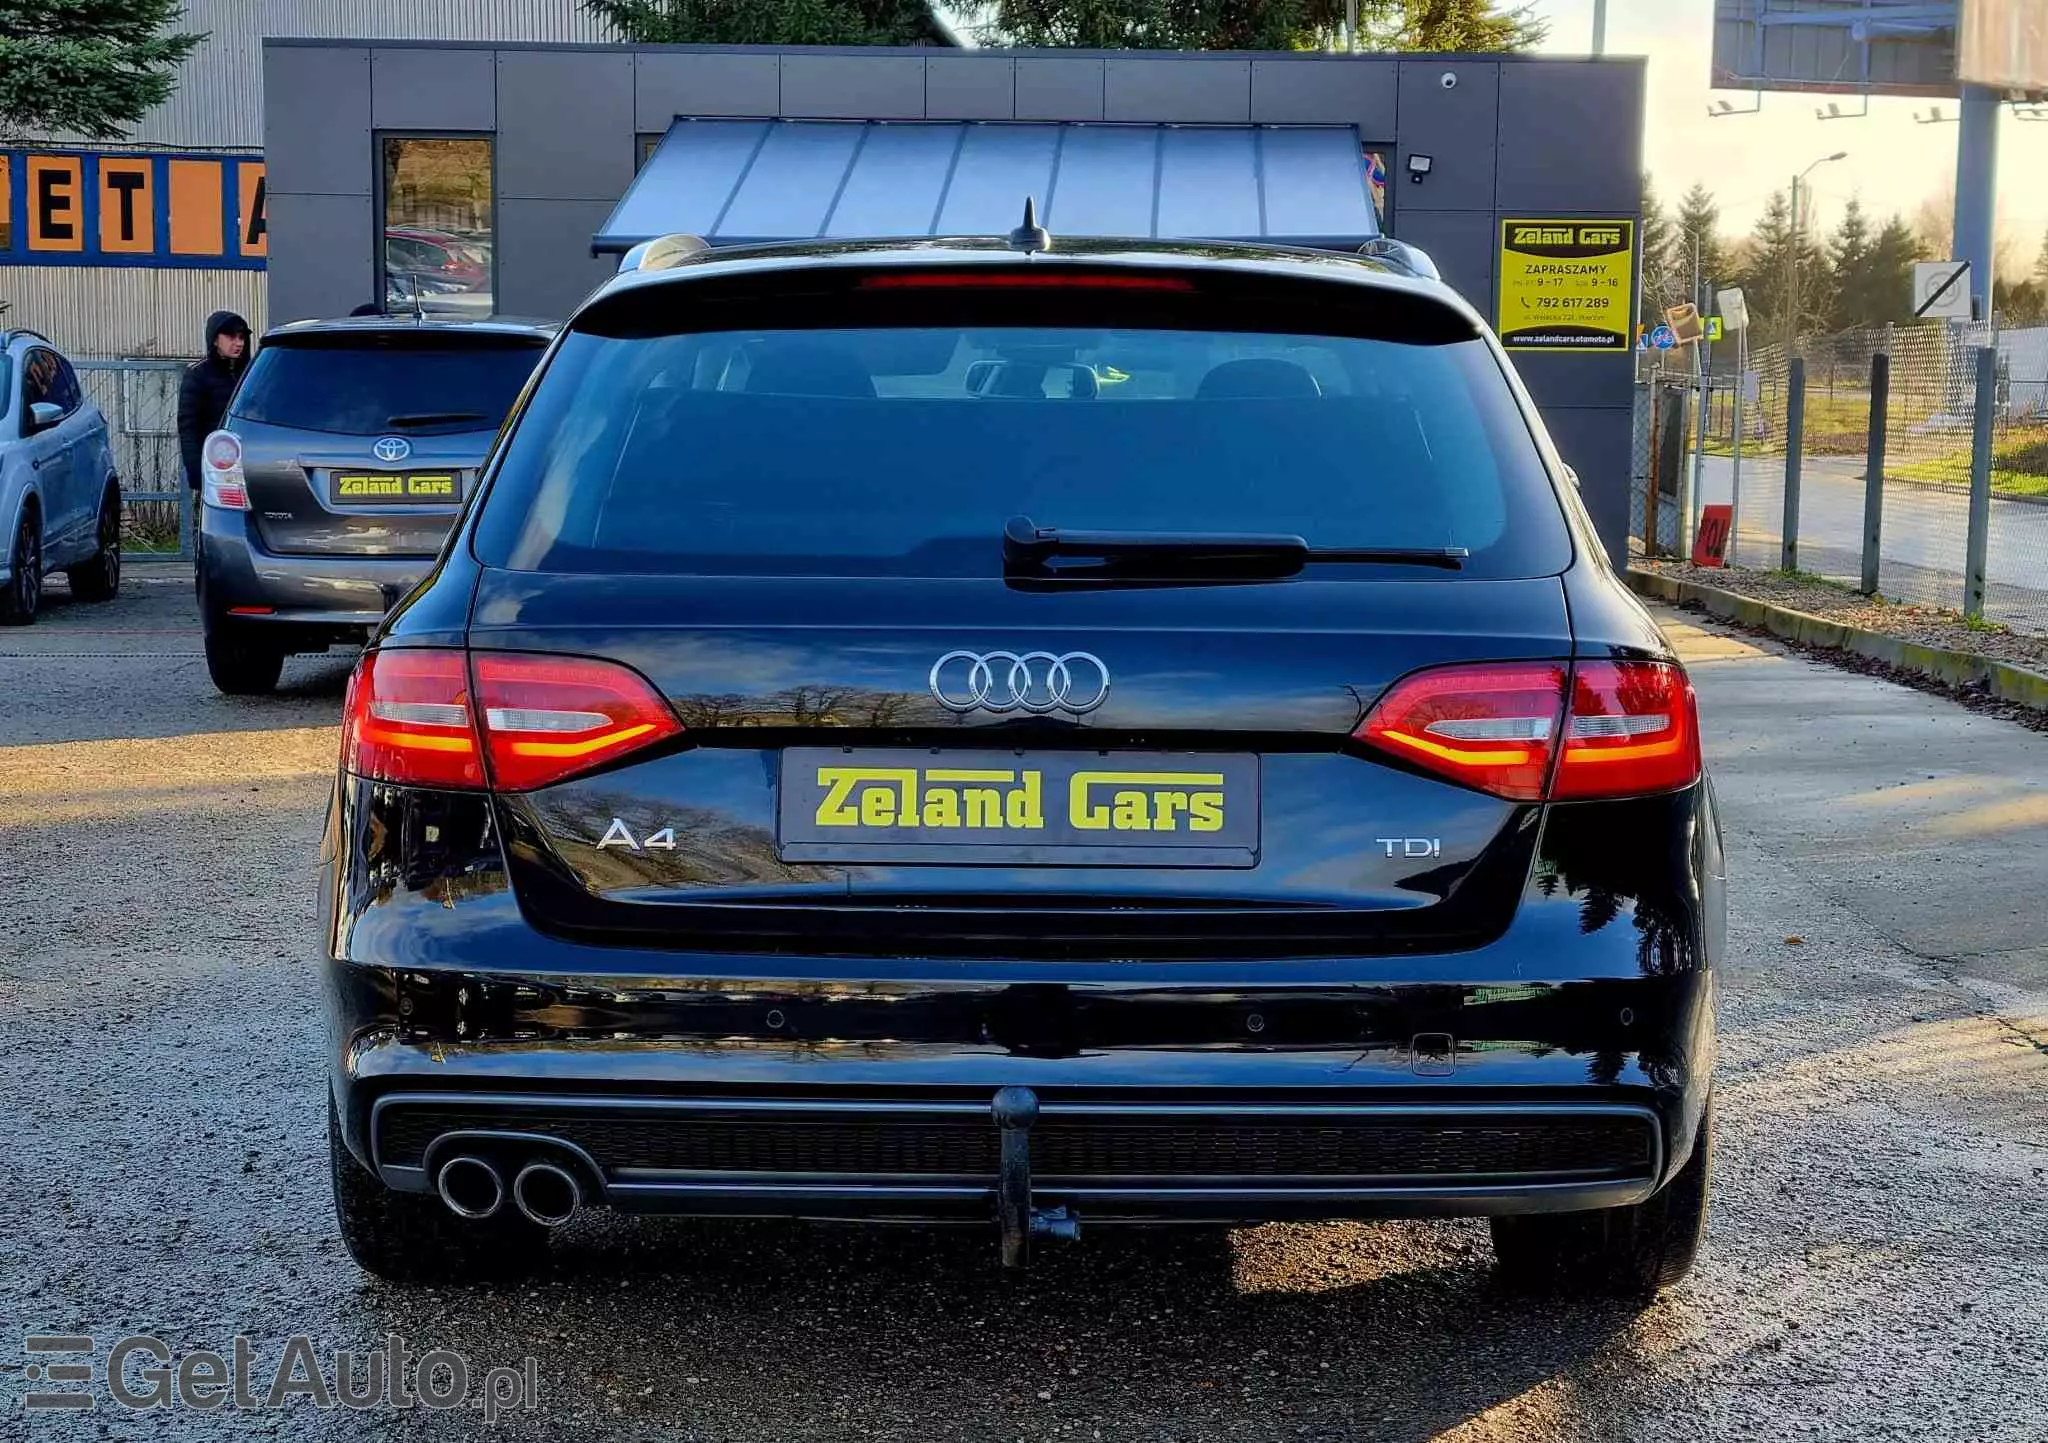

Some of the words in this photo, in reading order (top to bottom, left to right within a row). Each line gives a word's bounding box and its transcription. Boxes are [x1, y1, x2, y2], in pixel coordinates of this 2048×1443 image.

[1514, 228, 1574, 244] Zeland
[1579, 228, 1621, 244] Cars
[1525, 264, 1607, 274] ZAPRASZAMY
[1536, 298, 1559, 308] 792
[1562, 298, 1582, 308] 617
[1585, 298, 1610, 308] 289
[1512, 334, 1615, 344] www.zelandcars.otomoto.pl
[339, 476, 403, 494] Zeland
[408, 476, 453, 494] Cars
[815, 767, 1044, 828] Zeland
[1069, 771, 1225, 831] Cars
[596, 818, 677, 850] A4
[1375, 838, 1440, 857] TDI
